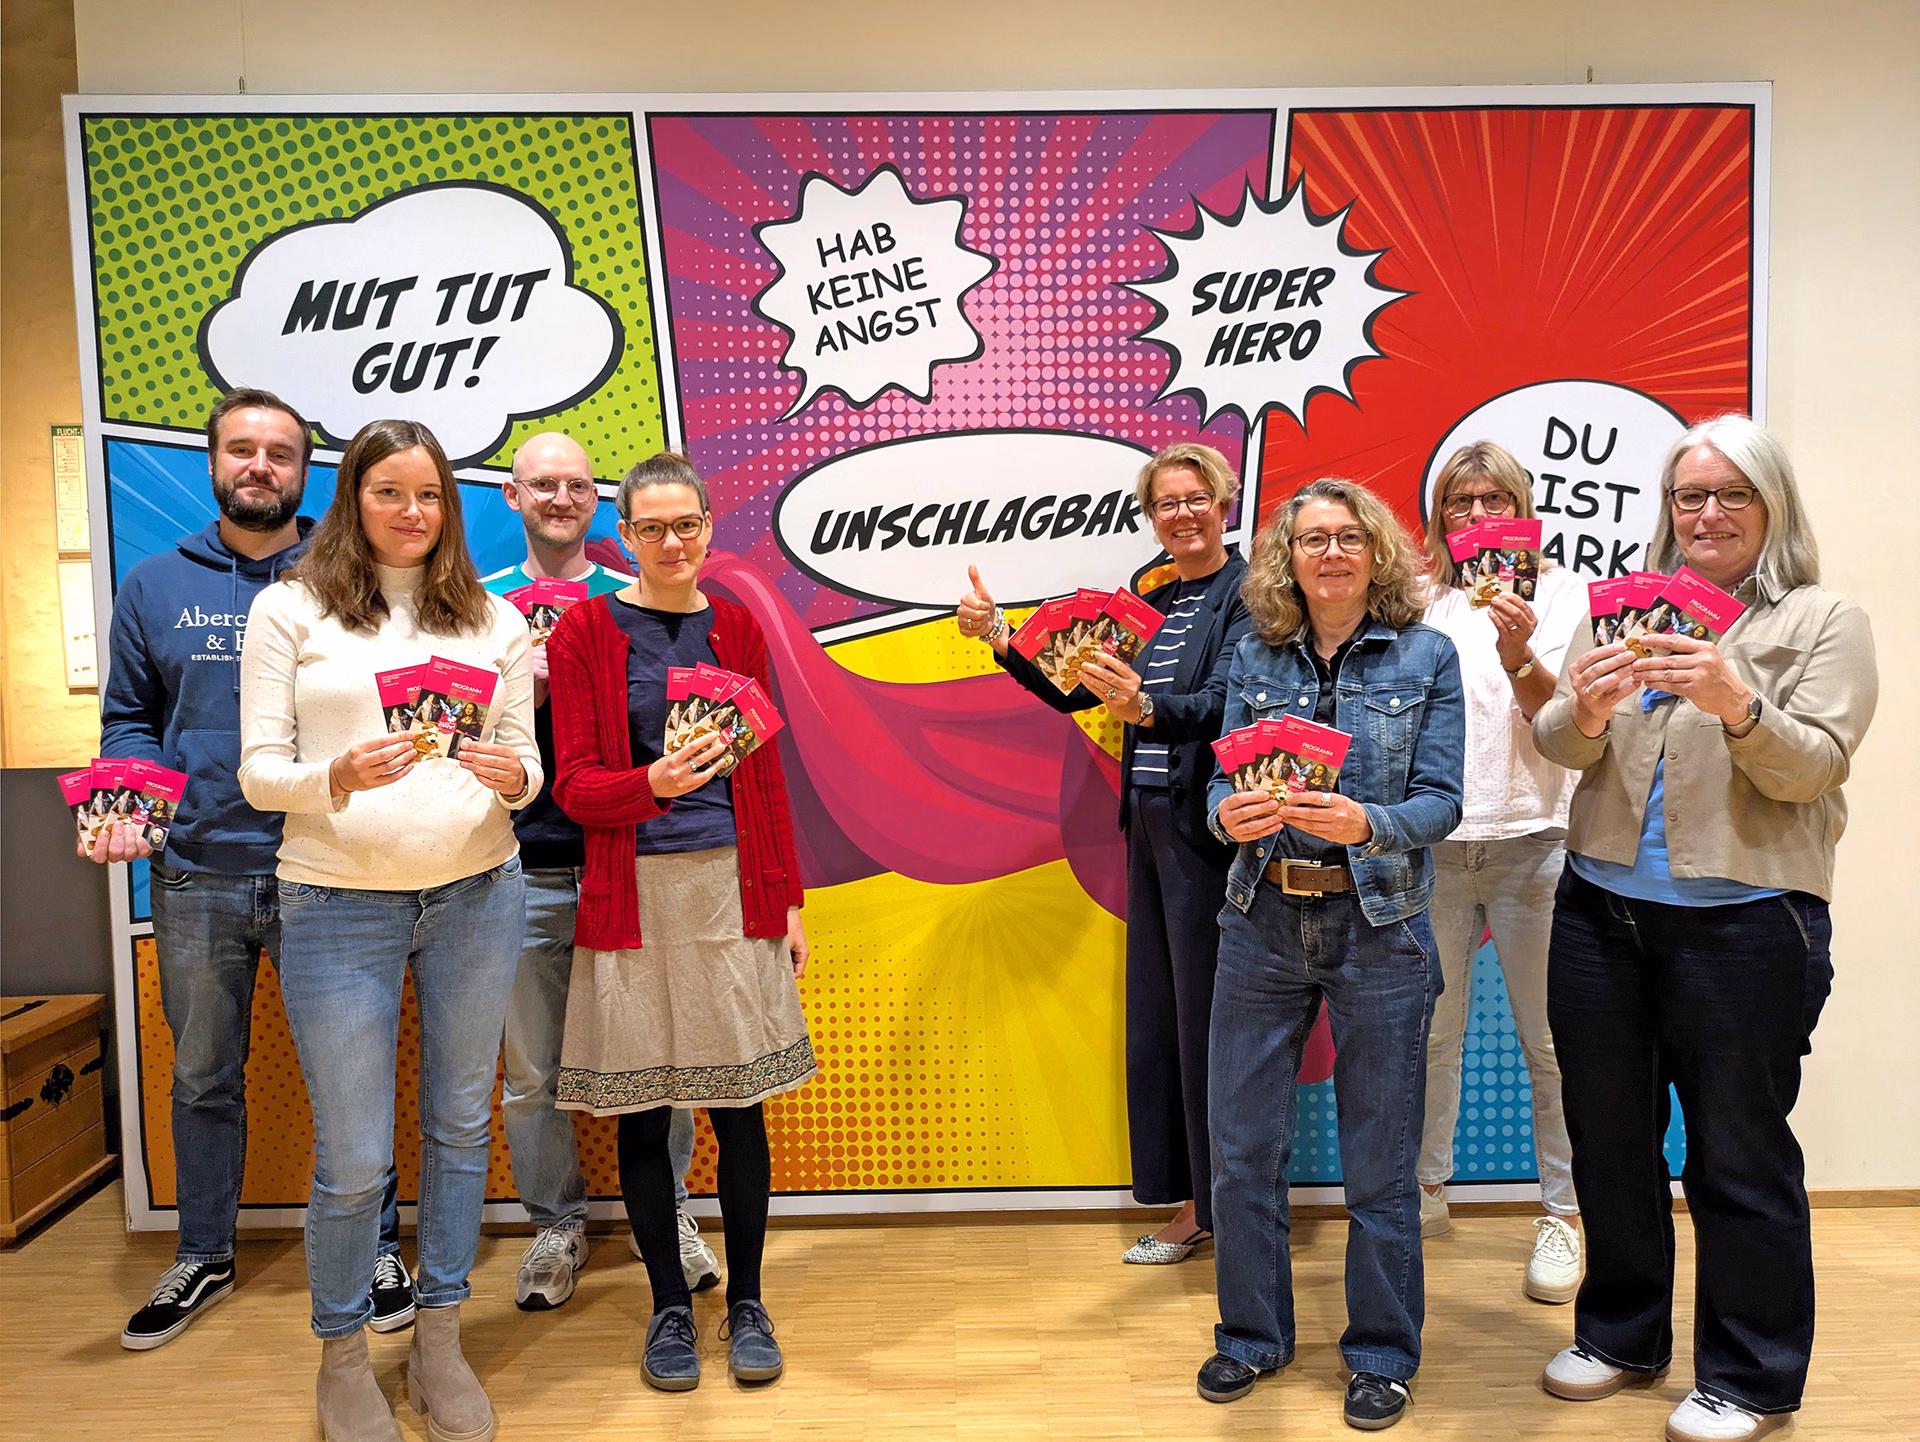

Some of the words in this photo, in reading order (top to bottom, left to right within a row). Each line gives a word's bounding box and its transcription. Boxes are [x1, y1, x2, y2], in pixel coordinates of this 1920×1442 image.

[817, 222, 896, 268] HAB
[281, 275, 419, 336] MUT
[436, 268, 551, 326] TUT
[807, 257, 927, 315] KEINE
[1192, 266, 1336, 317] SUPER
[816, 297, 941, 356] ANGST
[1204, 319, 1322, 368] HERO
[352, 336, 501, 394] GUT!
[1543, 416, 1617, 465] DU
[1524, 469, 1640, 523] IST
[810, 489, 1142, 555] UNSCHLAGBAR
[1542, 532, 1652, 578] ARK
[174, 606, 247, 629] Aberc
[554, 594, 579, 602] PROGRAMM
[1690, 599, 1721, 621] PROGRAMM
[206, 634, 226, 650] &
[1125, 613, 1148, 631] PROGRAMM
[451, 682, 483, 694] PROGRAMM
[749, 708, 766, 731] PROGRAMM
[1302, 742, 1334, 757] PROGRAMM
[146, 780, 173, 793] PROGRAMM
